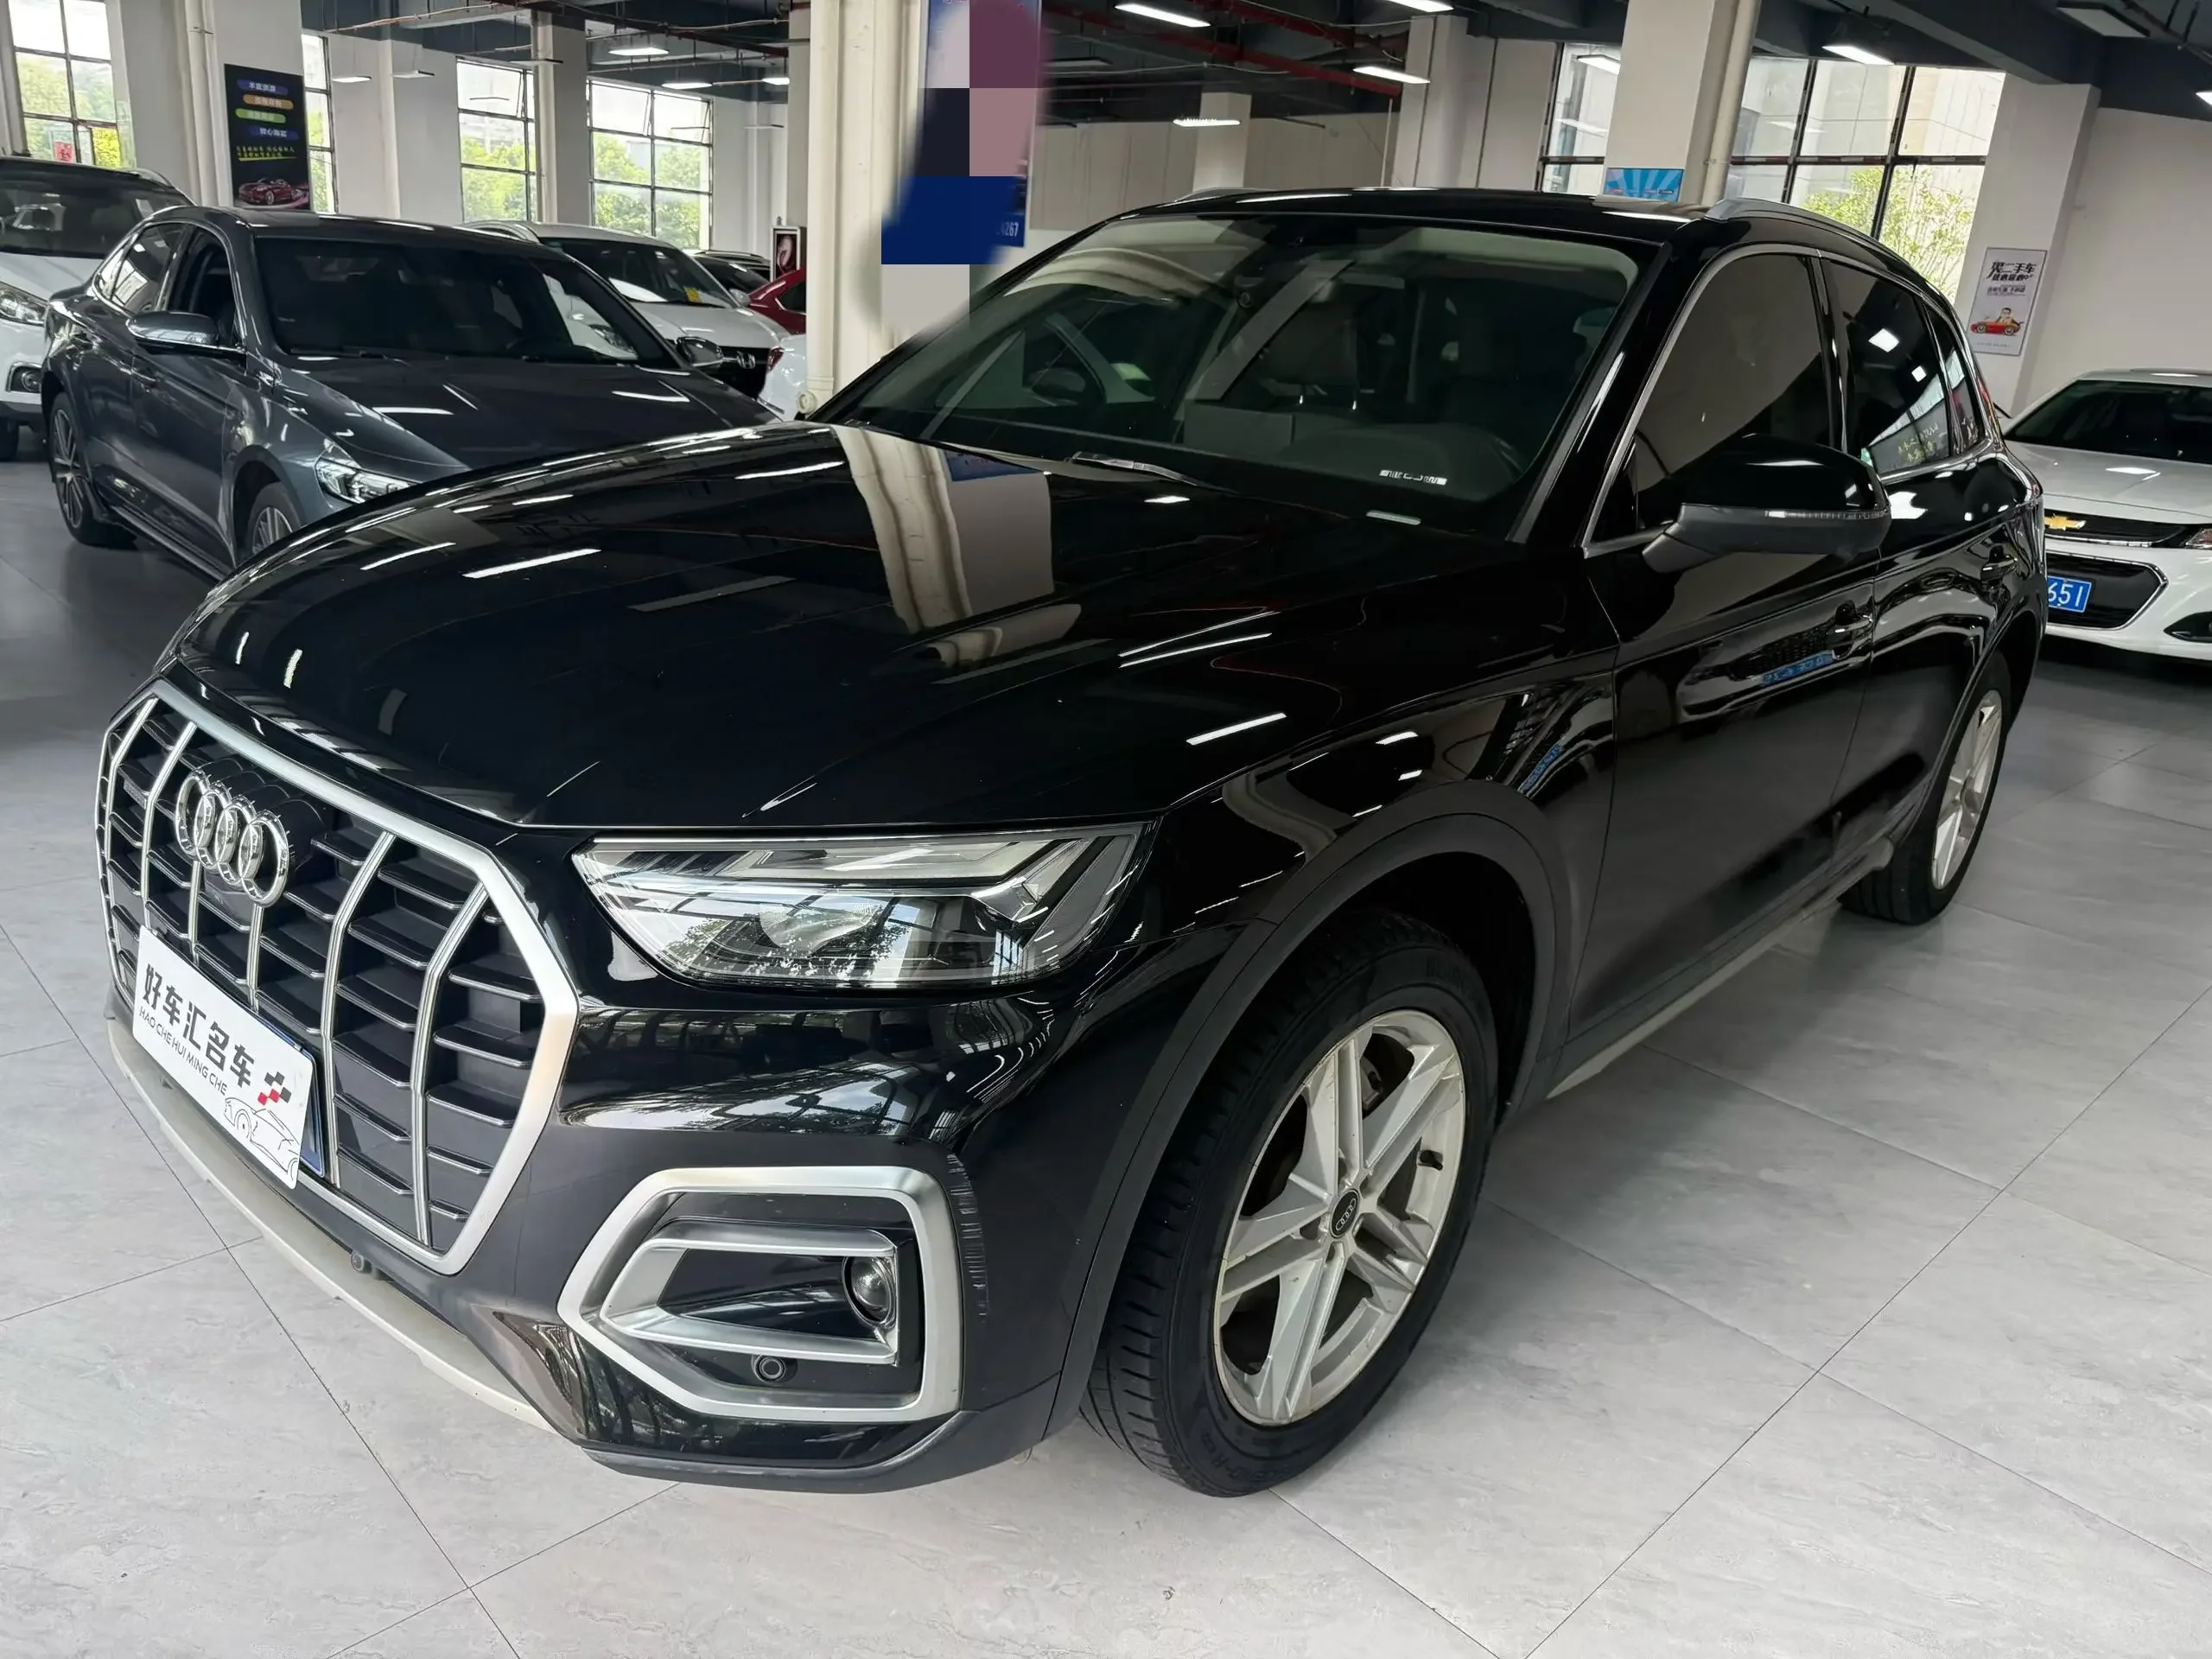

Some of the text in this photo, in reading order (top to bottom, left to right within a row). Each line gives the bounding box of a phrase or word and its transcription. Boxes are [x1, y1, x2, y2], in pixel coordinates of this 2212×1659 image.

[2048, 582, 2083, 607] 651
[139, 1007, 227, 1096] HAO CHE HUI MING CHE
[143, 963, 254, 1088] 好车汇名车
